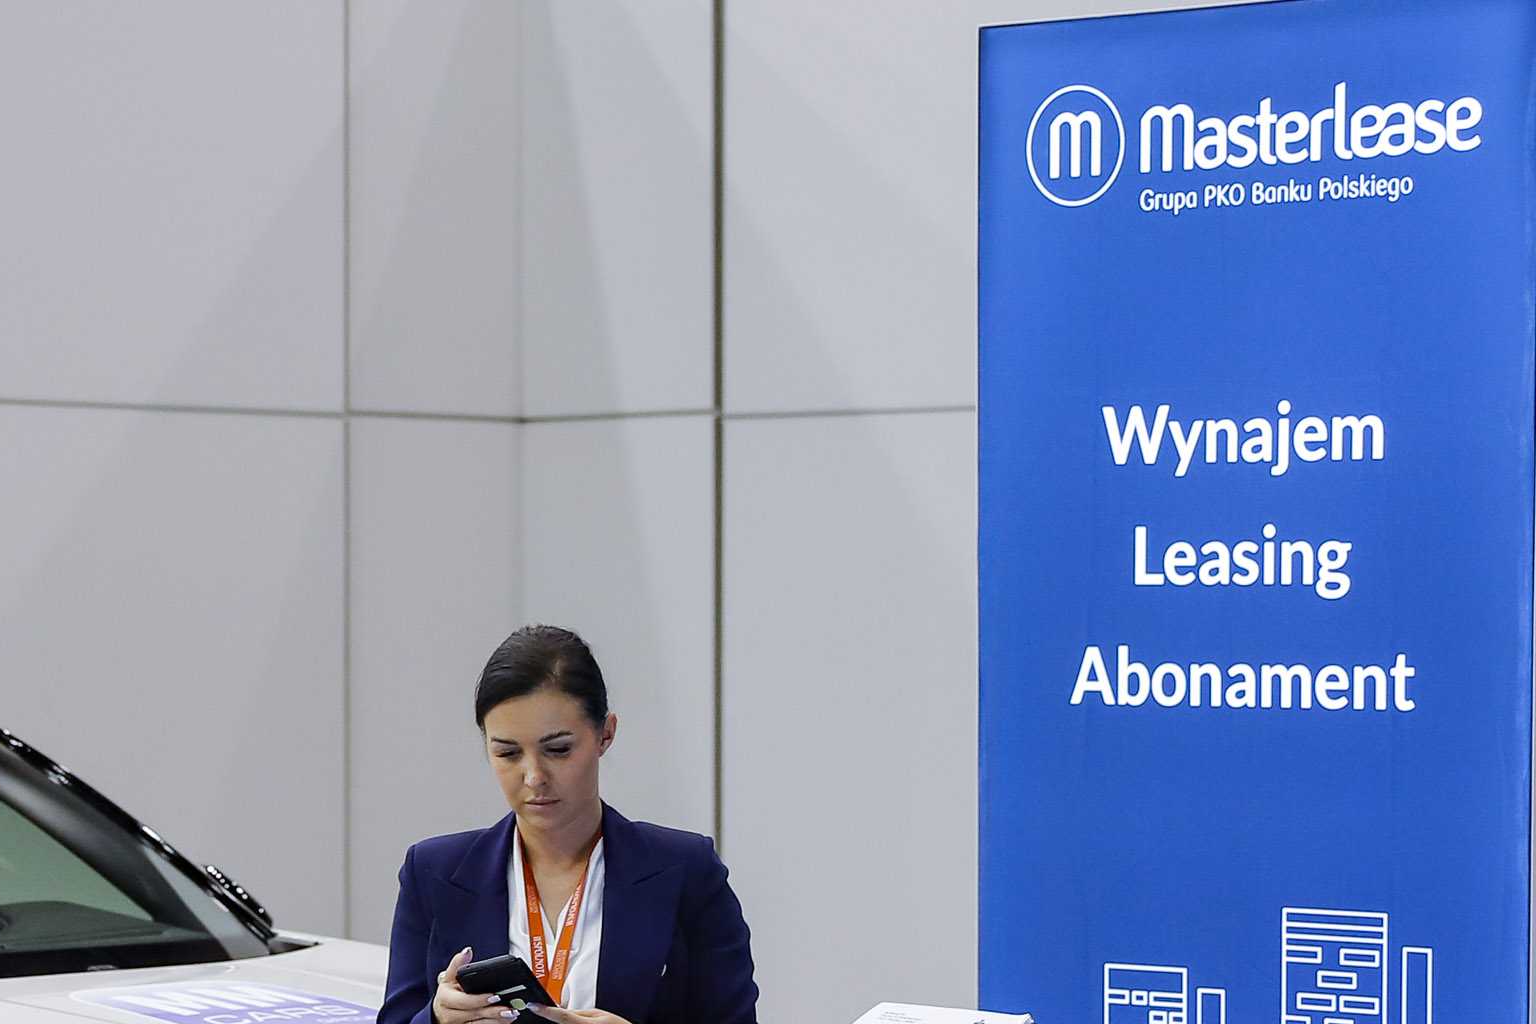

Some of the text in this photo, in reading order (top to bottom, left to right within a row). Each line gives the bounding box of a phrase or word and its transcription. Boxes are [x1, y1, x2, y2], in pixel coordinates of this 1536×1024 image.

[1139, 81, 1483, 174] Masterlease
[1139, 173, 1414, 216] Grupa PKO Banku Polskiego
[1101, 400, 1385, 477] Wynajem
[1134, 523, 1352, 600] Leasing
[1069, 645, 1416, 712] Abonament
